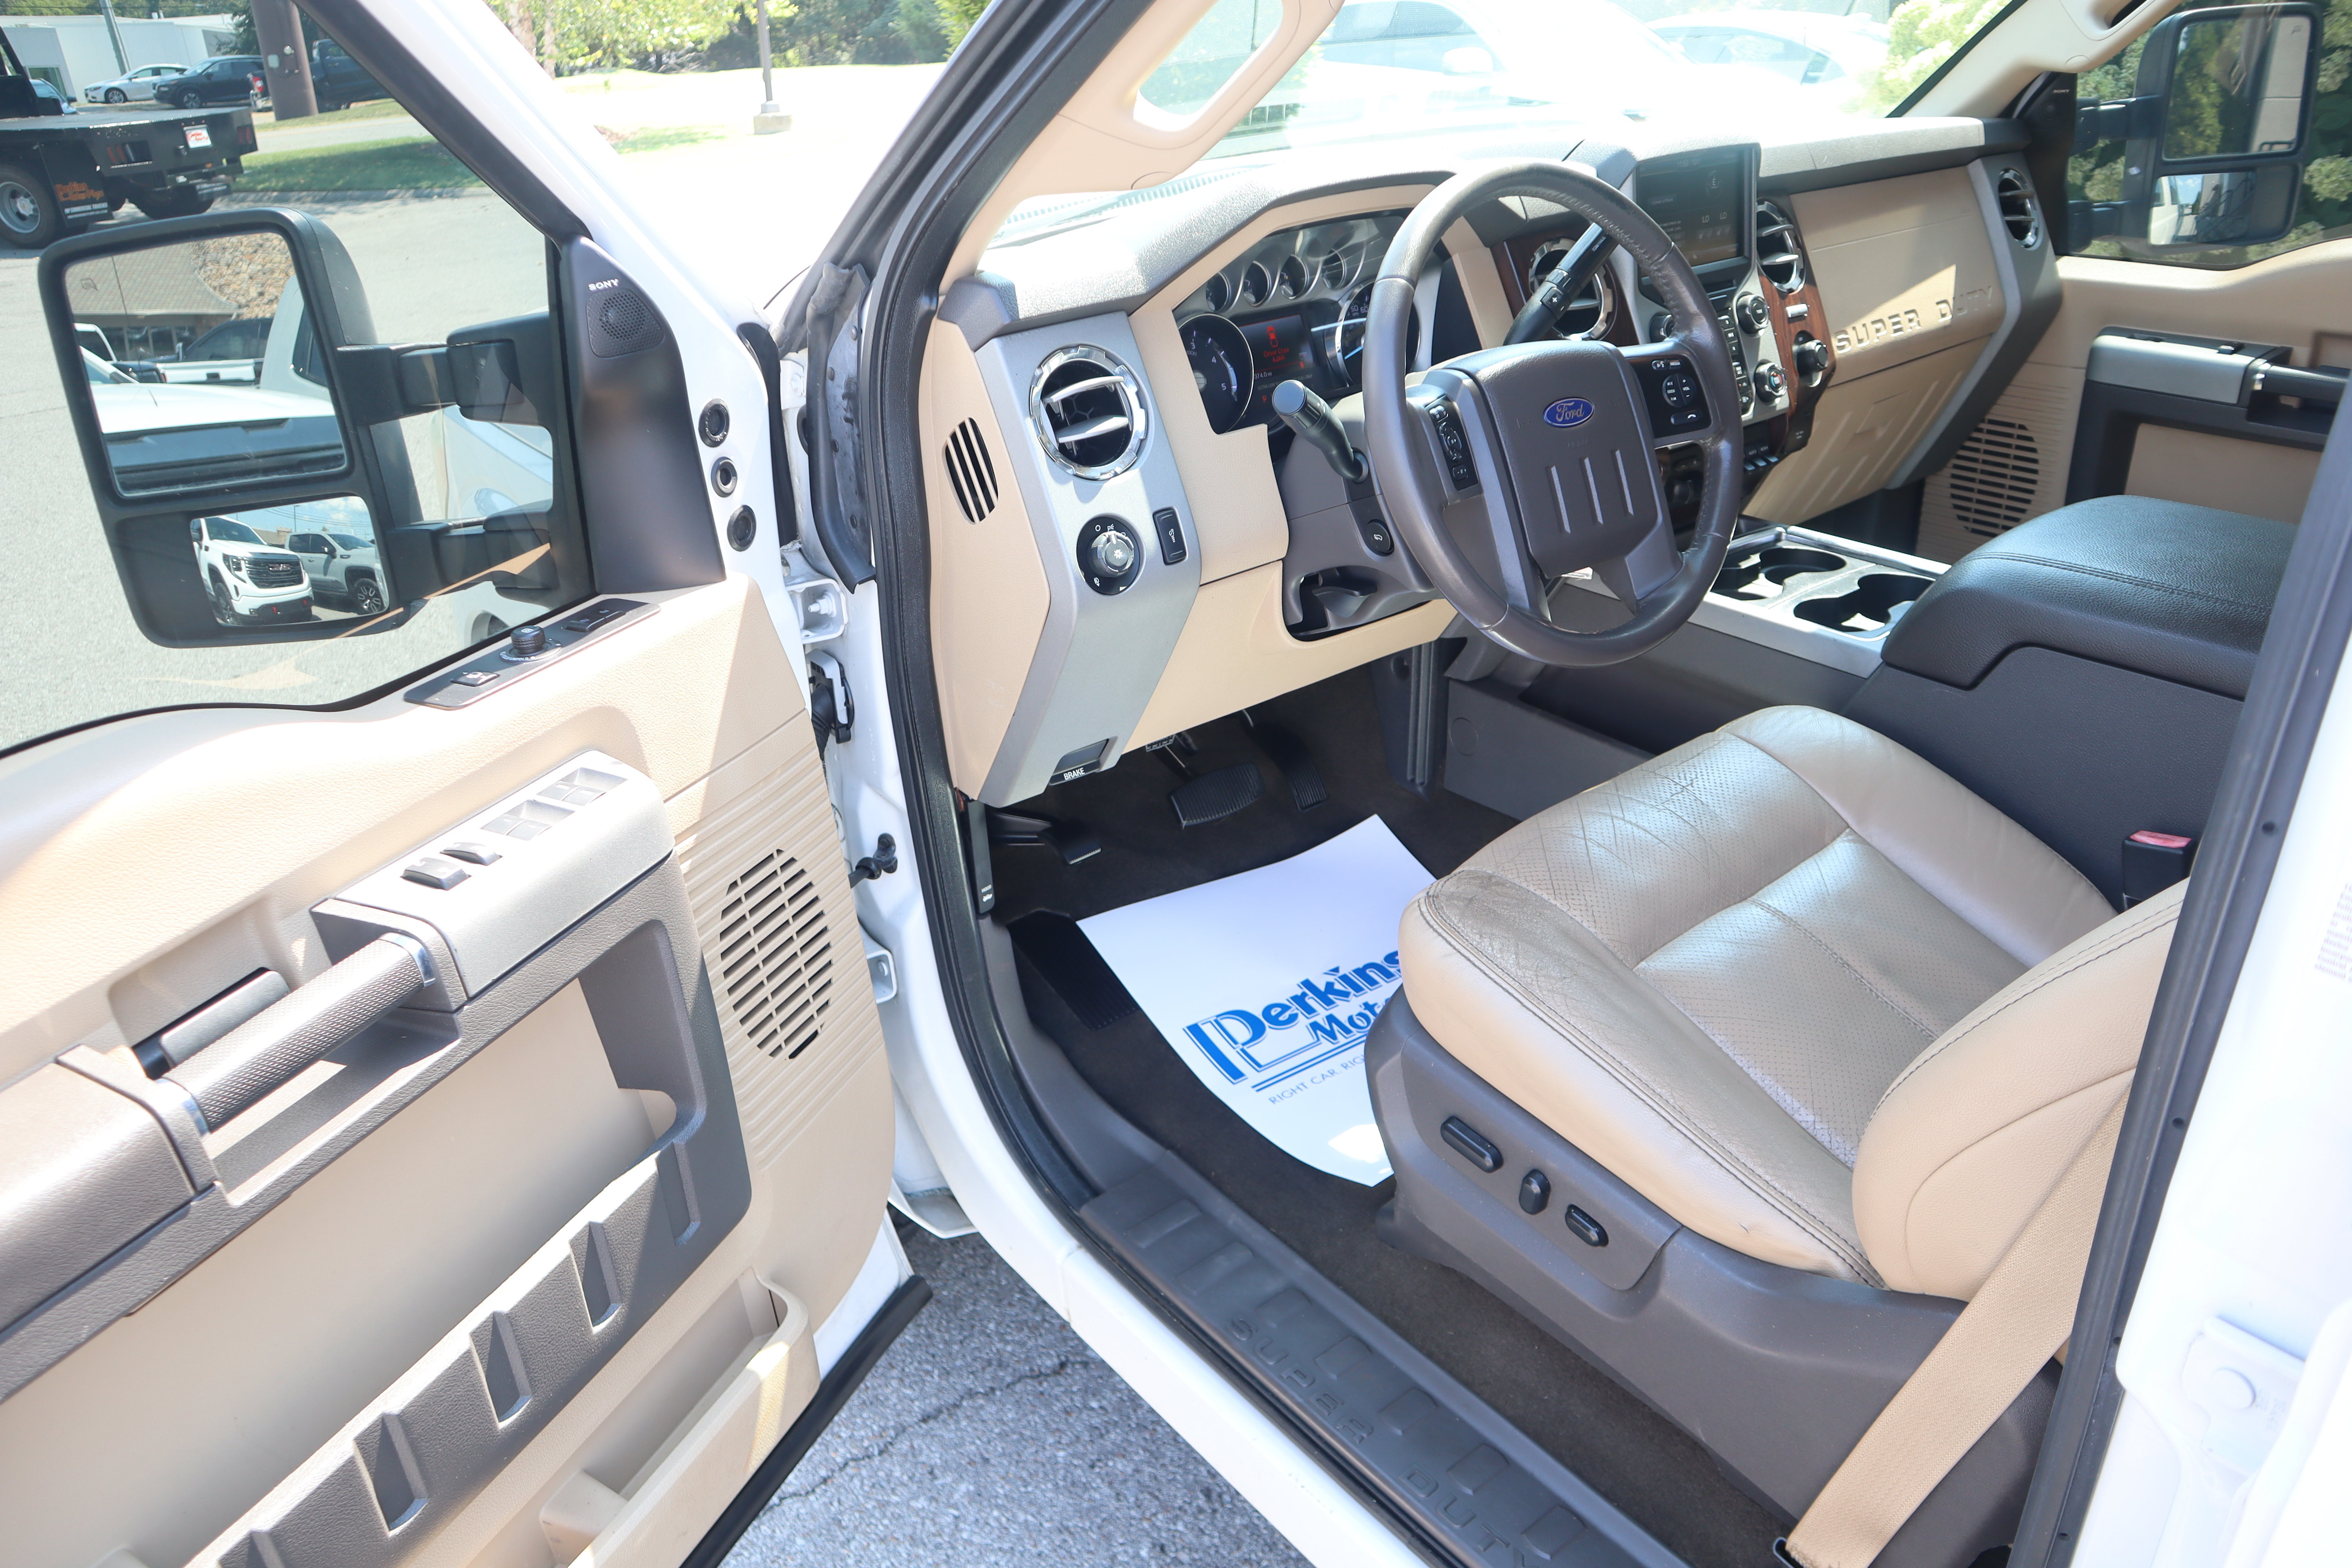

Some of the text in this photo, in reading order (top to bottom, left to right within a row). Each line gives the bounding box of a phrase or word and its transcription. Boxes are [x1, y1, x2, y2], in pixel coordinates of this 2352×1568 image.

[588, 278, 619, 290] SONY
[1835, 286, 1993, 354] SUPER DUTY
[1556, 401, 1585, 422] Ford
[1063, 767, 1085, 780] BRAKE
[981, 884, 992, 893] HOOD
[1306, 997, 1391, 1045] Mot
[1268, 1054, 1365, 1104] RIGHT CAR. RIG
[1227, 1314, 1375, 1445] SUPER
